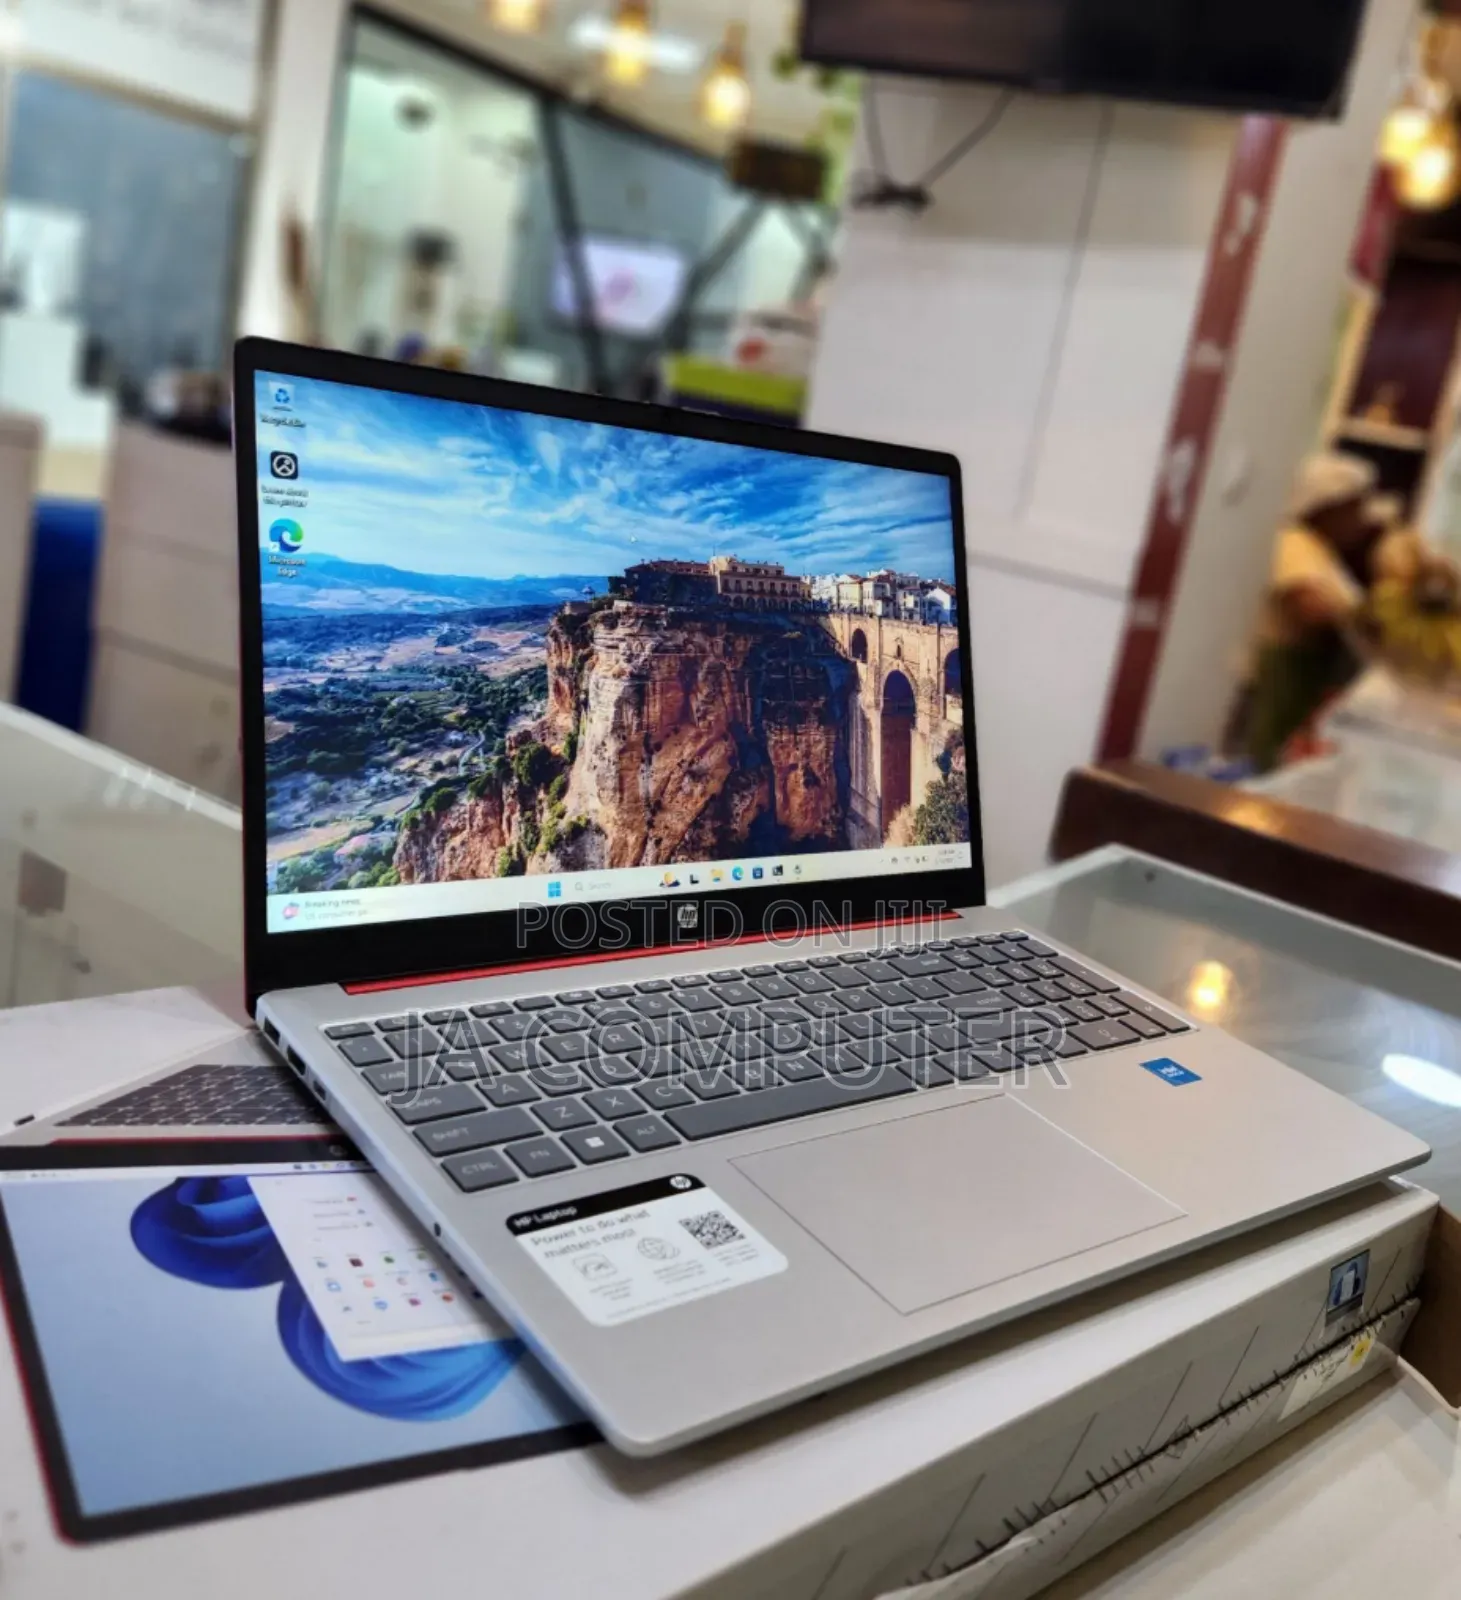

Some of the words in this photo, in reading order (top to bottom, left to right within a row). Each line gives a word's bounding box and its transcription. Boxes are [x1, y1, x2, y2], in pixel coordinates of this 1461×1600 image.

[608, 1033, 625, 1044] R
[561, 1040, 578, 1052] E
[501, 1084, 520, 1096] A
[655, 1086, 674, 1098] C
[607, 1095, 624, 1107] X
[554, 1106, 575, 1119] Z
[432, 1127, 470, 1141] SHIFT
[636, 1124, 659, 1136] ALT
[530, 1149, 550, 1160] FN
[461, 1160, 498, 1175] CTRL
[514, 1216, 532, 1229] HP
[533, 1207, 577, 1224] Laptop
[531, 1230, 577, 1246] Power
[578, 1224, 596, 1235] to
[616, 1209, 651, 1224] what
[544, 1239, 602, 1259] matters
